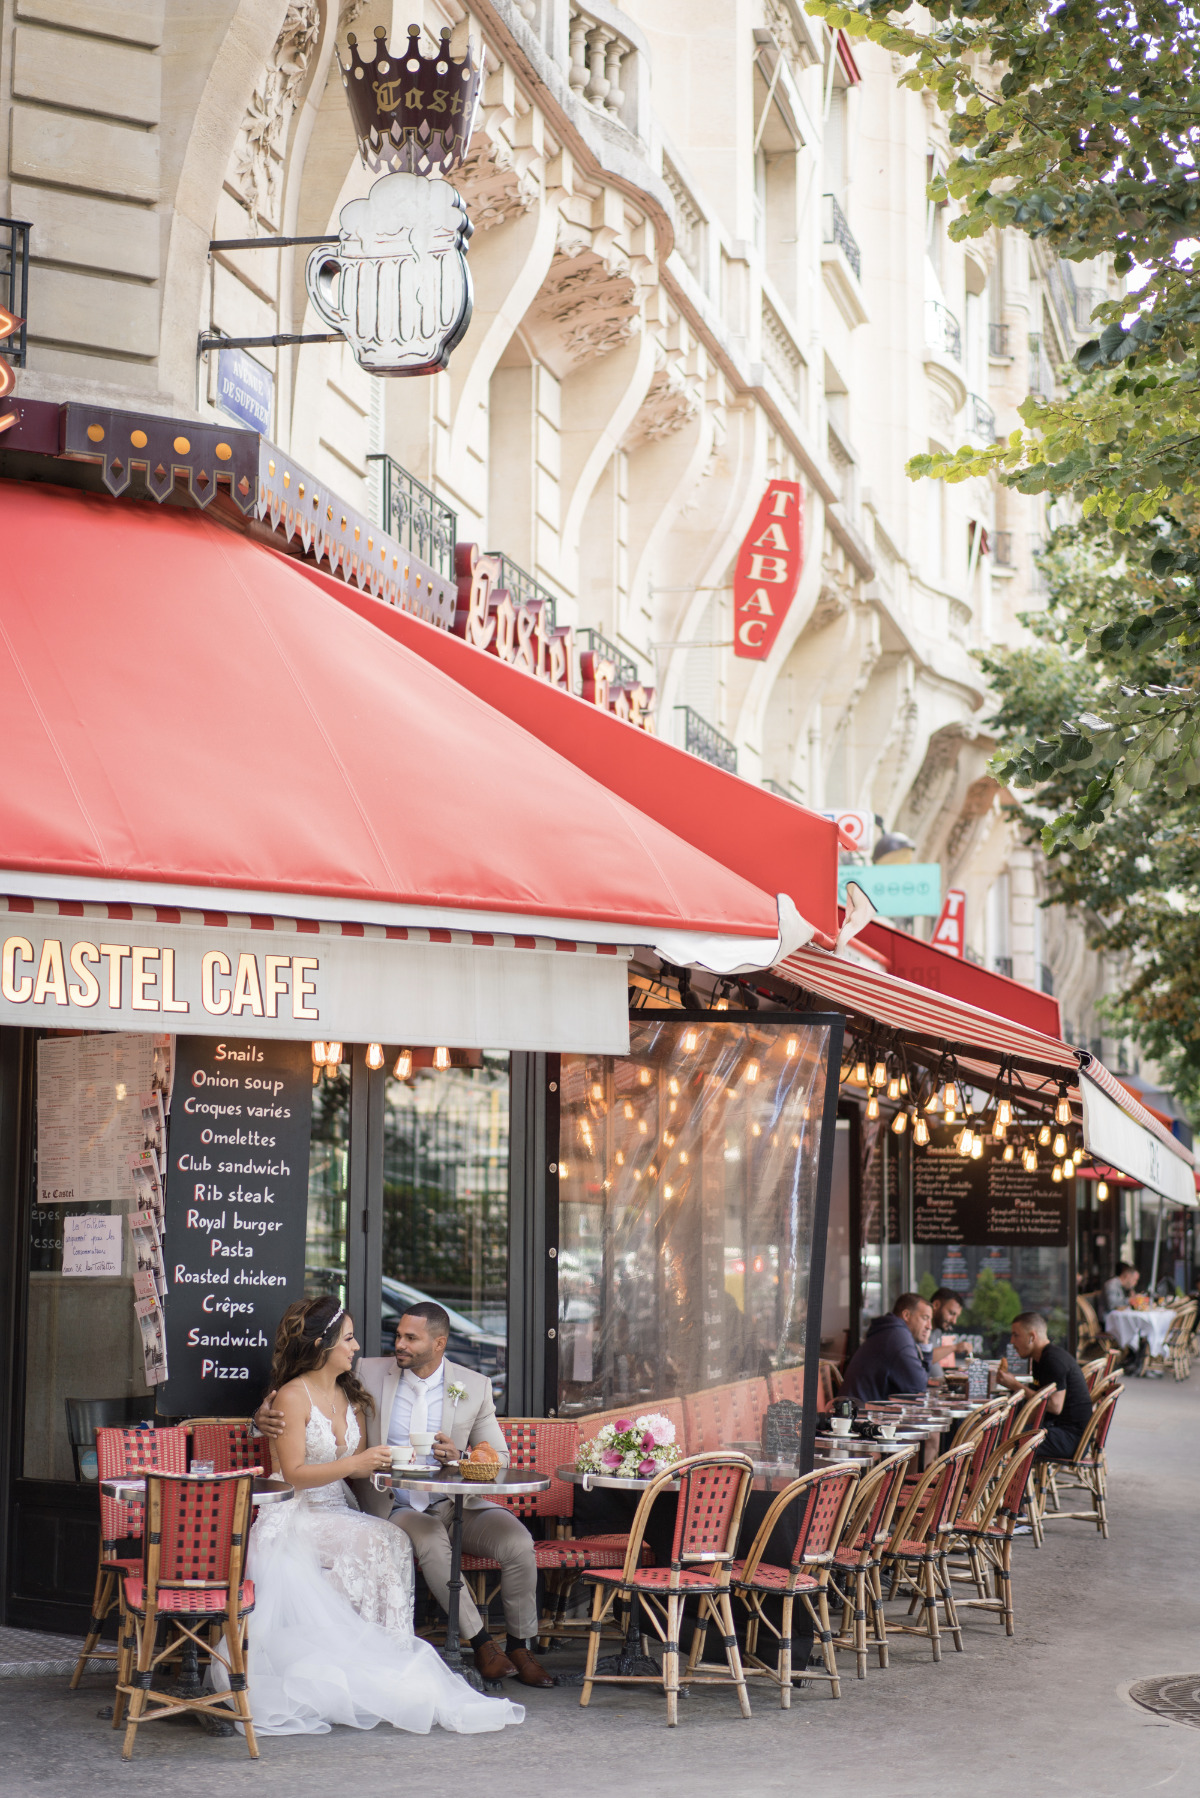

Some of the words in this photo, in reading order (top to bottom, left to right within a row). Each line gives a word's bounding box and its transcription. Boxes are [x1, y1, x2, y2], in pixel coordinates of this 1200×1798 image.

[233, 361, 263, 396] AVENUE
[223, 377, 235, 399] DE
[235, 386, 269, 425] SUFFREN
[738, 490, 795, 648] TABAC
[1, 935, 190, 1013] CASTEL
[201, 950, 319, 1020] CAFE
[214, 1043, 264, 1062] Snails
[191, 1069, 239, 1088] Onion
[244, 1077, 284, 1097] soup
[184, 1096, 242, 1119] Croques
[246, 1102, 291, 1118] variés
[200, 1128, 276, 1147] Omelettes
[177, 1154, 212, 1171] Club
[217, 1158, 290, 1176] sandwich
[42, 1189, 51, 1199] Le
[52, 1189, 74, 1198] Castel
[194, 1183, 223, 1201] Rib
[227, 1184, 275, 1203] steak
[1014, 1198, 1036, 1209] Pasta
[187, 1209, 226, 1235] Royal
[233, 1211, 283, 1236] burger
[211, 1239, 253, 1258] Pasta
[174, 1264, 229, 1284] Roasted
[233, 1268, 287, 1286] chicken
[202, 1294, 255, 1318] Crêpes
[186, 1327, 268, 1347] Sandwich
[201, 1359, 249, 1379] Pizza
